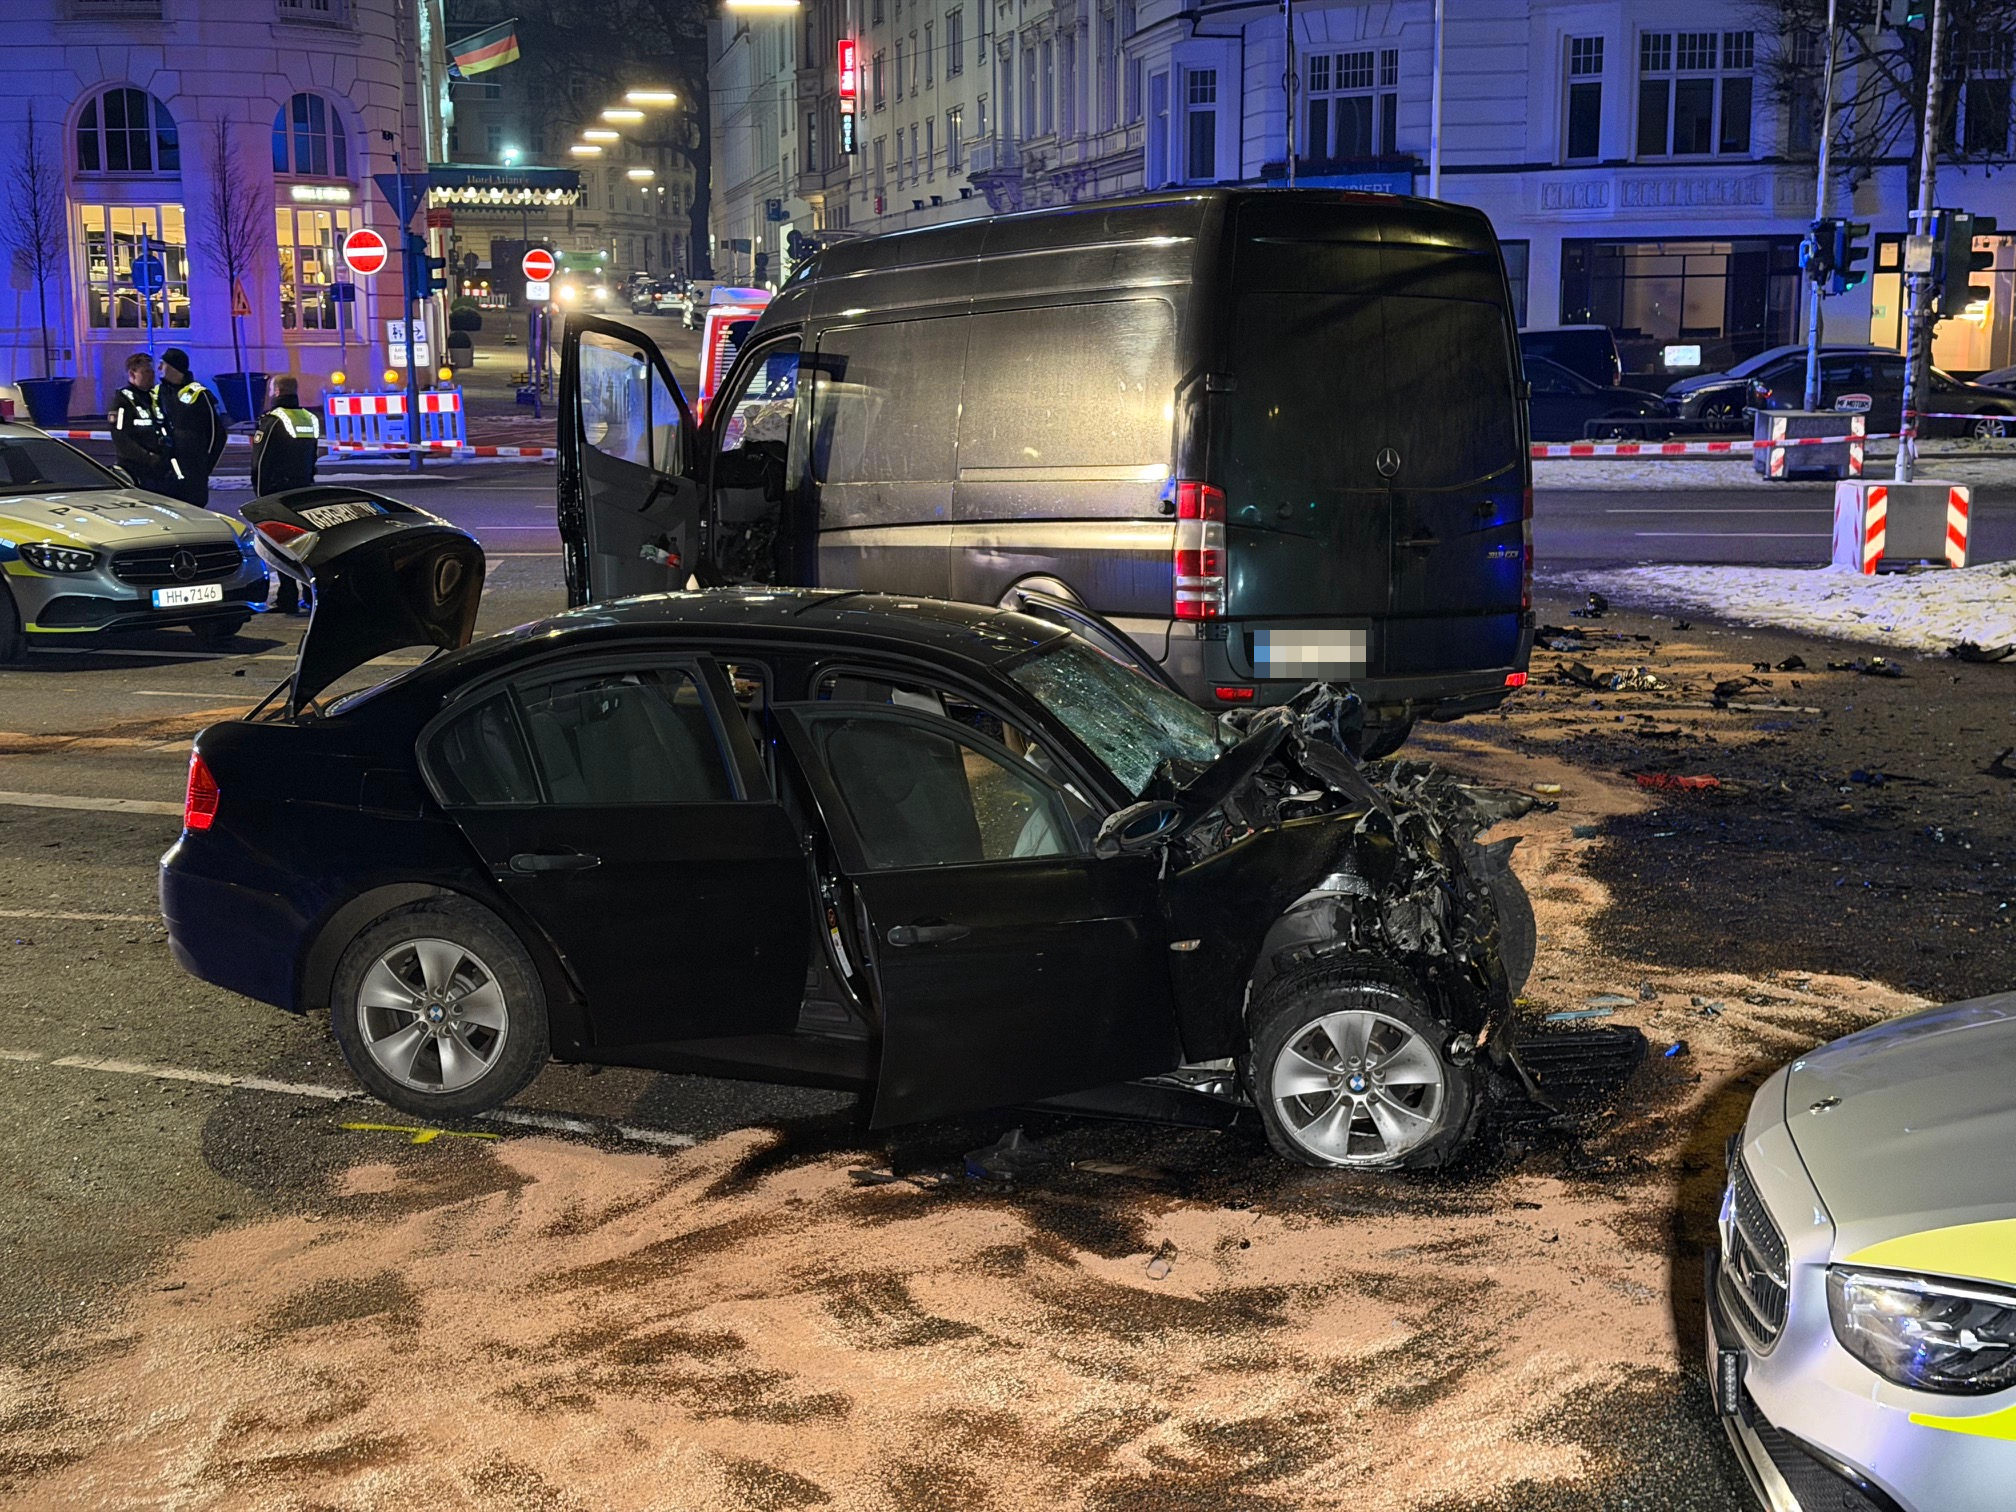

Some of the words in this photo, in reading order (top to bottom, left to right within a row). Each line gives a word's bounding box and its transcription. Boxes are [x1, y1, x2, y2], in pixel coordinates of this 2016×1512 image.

[843, 114, 852, 152] HOTEL
[467, 174, 492, 184] Hotel
[166, 590, 183, 604] HH
[190, 586, 217, 601] 7146
